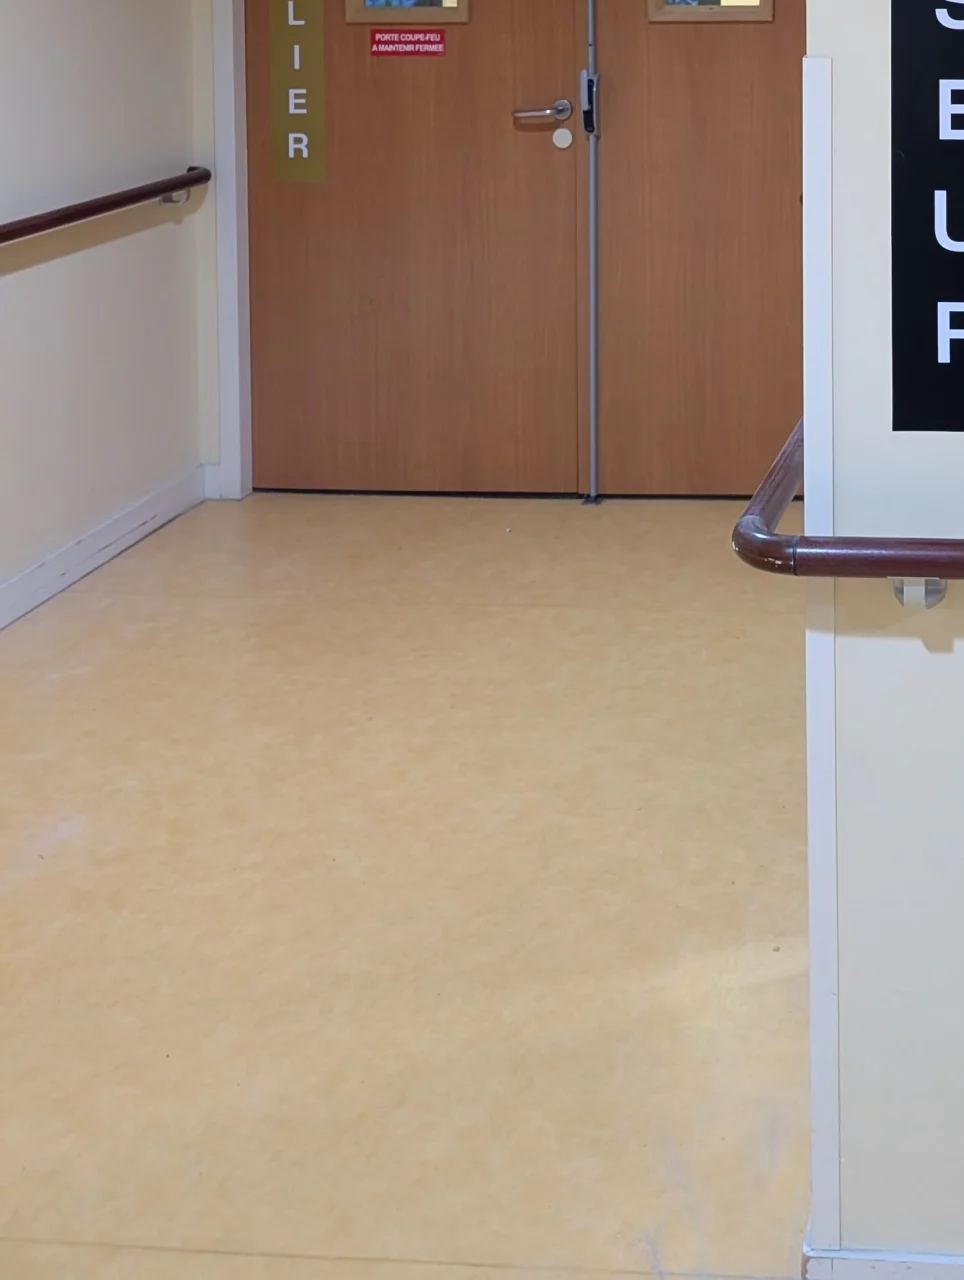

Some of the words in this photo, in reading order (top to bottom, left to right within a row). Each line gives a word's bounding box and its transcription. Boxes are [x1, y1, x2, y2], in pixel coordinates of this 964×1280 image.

[375, 33, 399, 41] PORTE
[400, 33, 441, 41] COUPE-FEU
[372, 44, 377, 52] A
[378, 44, 414, 52] MAINTENIR
